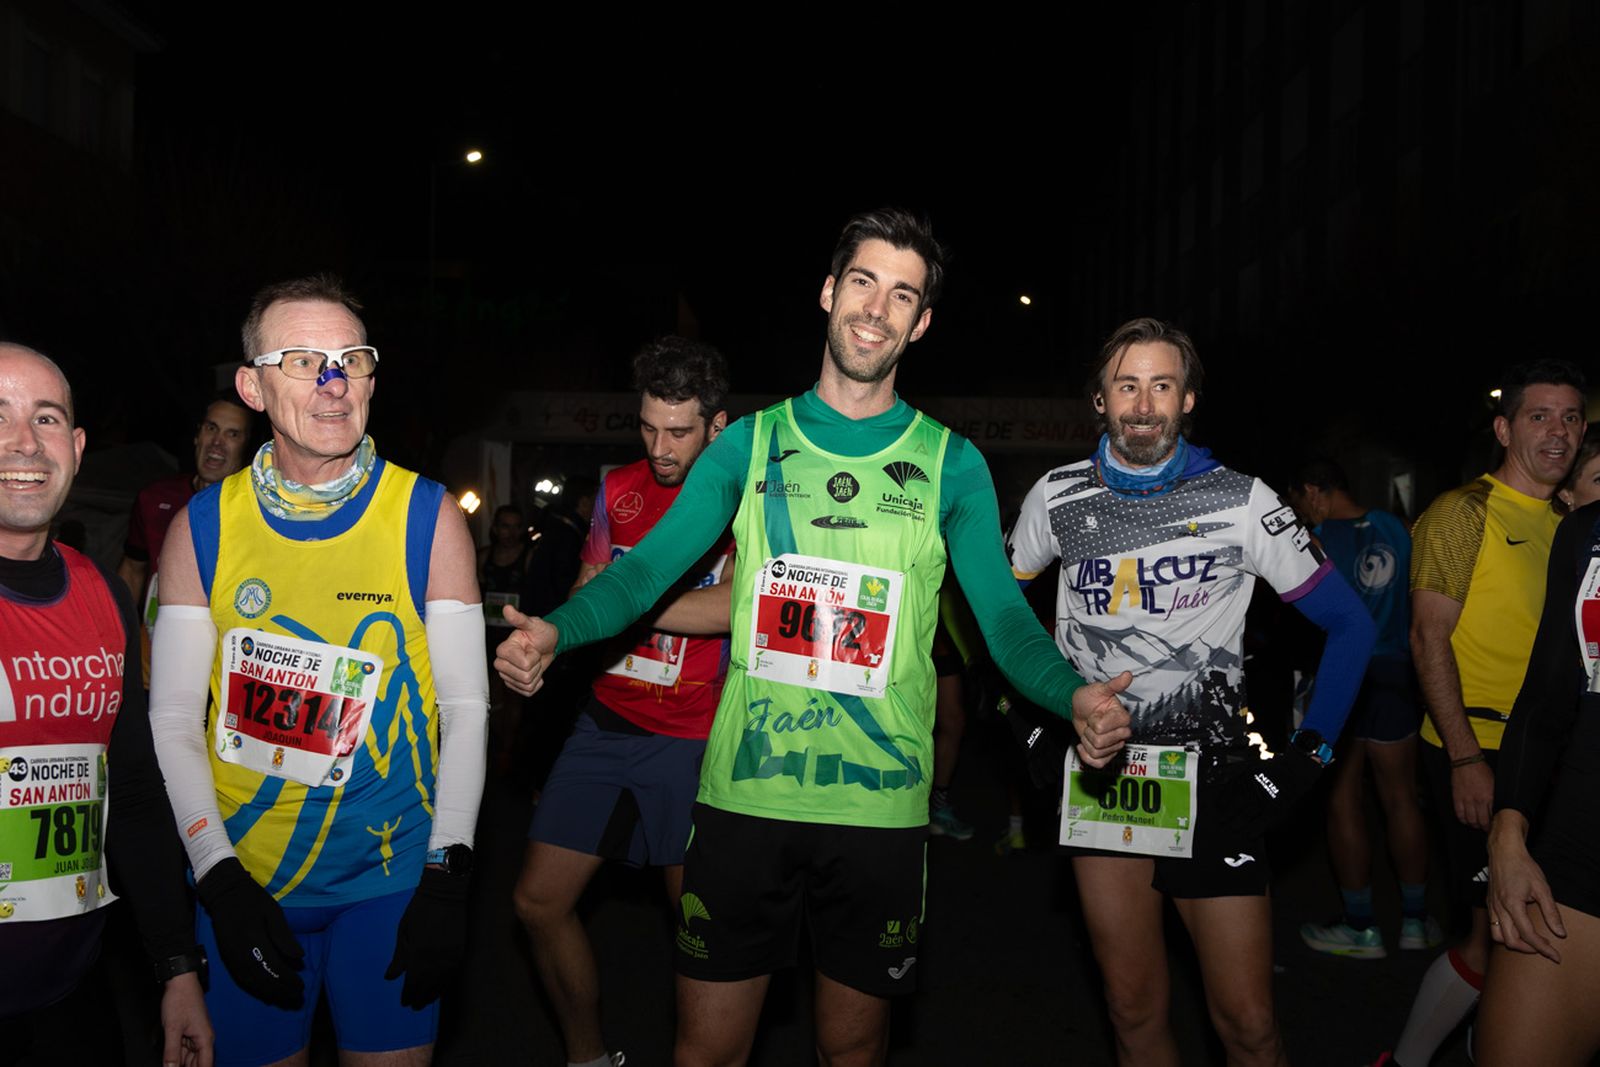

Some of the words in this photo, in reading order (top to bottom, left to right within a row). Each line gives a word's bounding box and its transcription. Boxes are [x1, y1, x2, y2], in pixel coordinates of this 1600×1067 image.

[984, 419, 1014, 441] DE
[769, 480, 800, 493] Jaén
[882, 493, 923, 510] Unicaja
[772, 563, 786, 574] 43
[787, 569, 829, 586] NOCHE
[830, 575, 848, 589] DE
[769, 582, 797, 598] SAN
[255, 647, 301, 668] NOCHE
[304, 656, 322, 671] DE
[240, 660, 264, 680] SAN
[265, 668, 318, 690] ANTÓN
[243, 681, 346, 739] 12314
[745, 696, 843, 739] Jaén
[1132, 751, 1148, 762] DE
[10, 762, 27, 776] 43
[31, 764, 75, 781] NOCHE
[77, 763, 89, 778] DE
[9, 785, 45, 806] SAN
[48, 778, 91, 803] ANTÓN
[1102, 811, 1125, 823] Pedro
[1126, 813, 1155, 825] Manuel
[30, 803, 101, 860] 7879
[54, 859, 79, 874] JUAN
